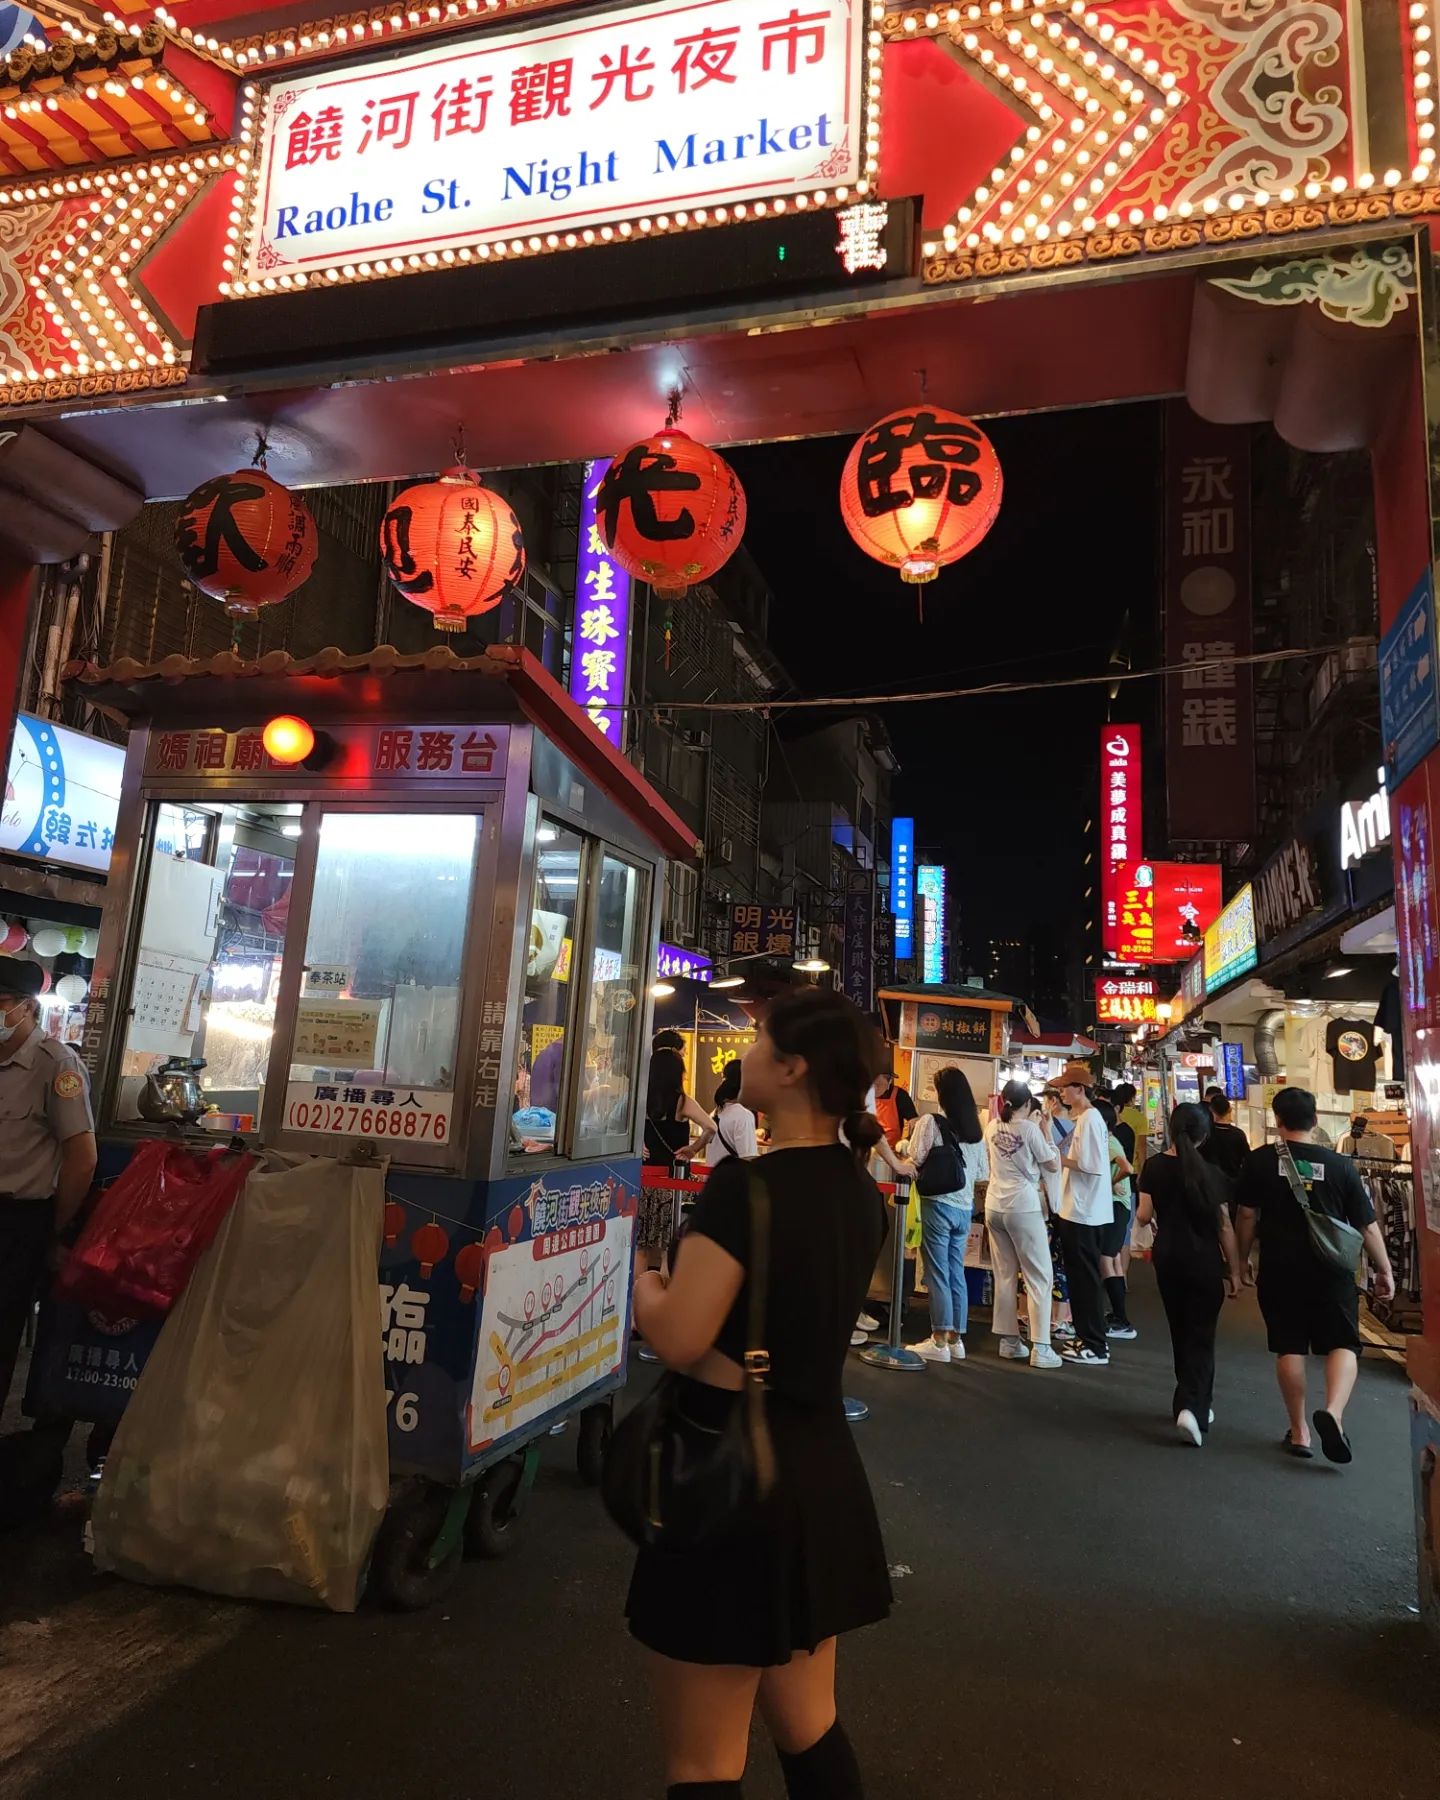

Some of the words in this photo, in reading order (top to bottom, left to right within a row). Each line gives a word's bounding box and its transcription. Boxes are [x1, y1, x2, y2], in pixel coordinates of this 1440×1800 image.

[284, 9, 830, 171] 饒河街觀光夜市
[275, 190, 393, 240] Raohe
[421, 178, 471, 215] St.
[501, 150, 620, 201] Night
[653, 111, 833, 174] Market
[858, 413, 982, 518] 臨
[1182, 457, 1235, 556] 永和
[455, 497, 481, 580] 國泰民安
[1182, 642, 1237, 747] 鐘錶
[155, 732, 299, 773] 媽祖廟
[374, 730, 499, 773] 服務台
[1109, 771, 1128, 874] 美夢成真鑽
[735, 906, 794, 929] 明光
[310, 971, 347, 986] 奉茶站
[1102, 980, 1153, 995] 金瑞利
[942, 1018, 987, 1037] 胡椒餅
[475, 1001, 506, 1108] 請靠右走
[711, 1046, 737, 1075] 胡
[314, 1085, 423, 1109] 廣播尋人
[289, 1102, 447, 1140] (02)27668876
[533, 1183, 611, 1233] 饒河街觀光夜市
[543, 1223, 600, 1256] 周邊公廁位置圖
